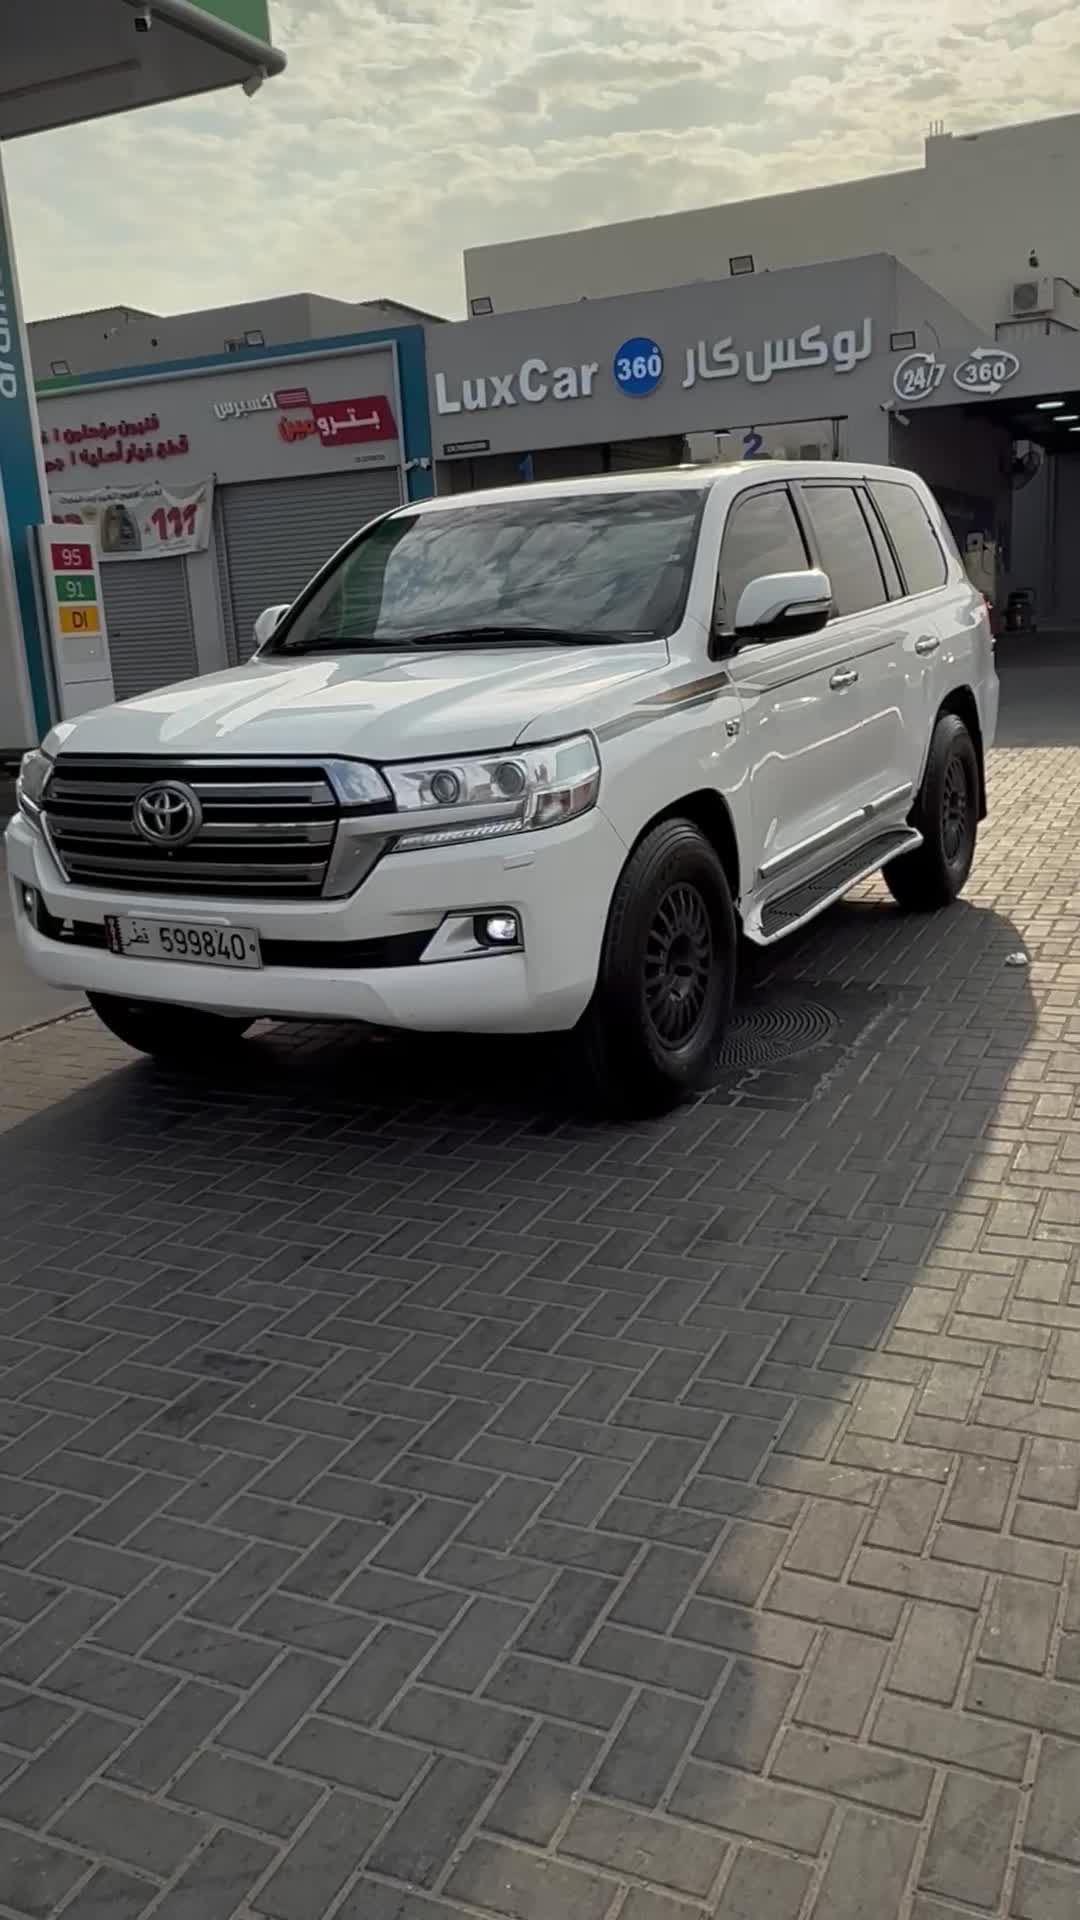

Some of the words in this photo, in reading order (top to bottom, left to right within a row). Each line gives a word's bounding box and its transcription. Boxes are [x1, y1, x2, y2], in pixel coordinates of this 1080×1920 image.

[682, 336, 741, 388] كار
[746, 317, 873, 384] لوكس
[434, 357, 600, 416] LuxCar
[903, 363, 947, 394] 24/7
[742, 432, 763, 459] 2
[61, 548, 82, 566] 95
[65, 580, 86, 598] 91
[71, 610, 89, 629] DI
[159, 927, 246, 961] 599840
